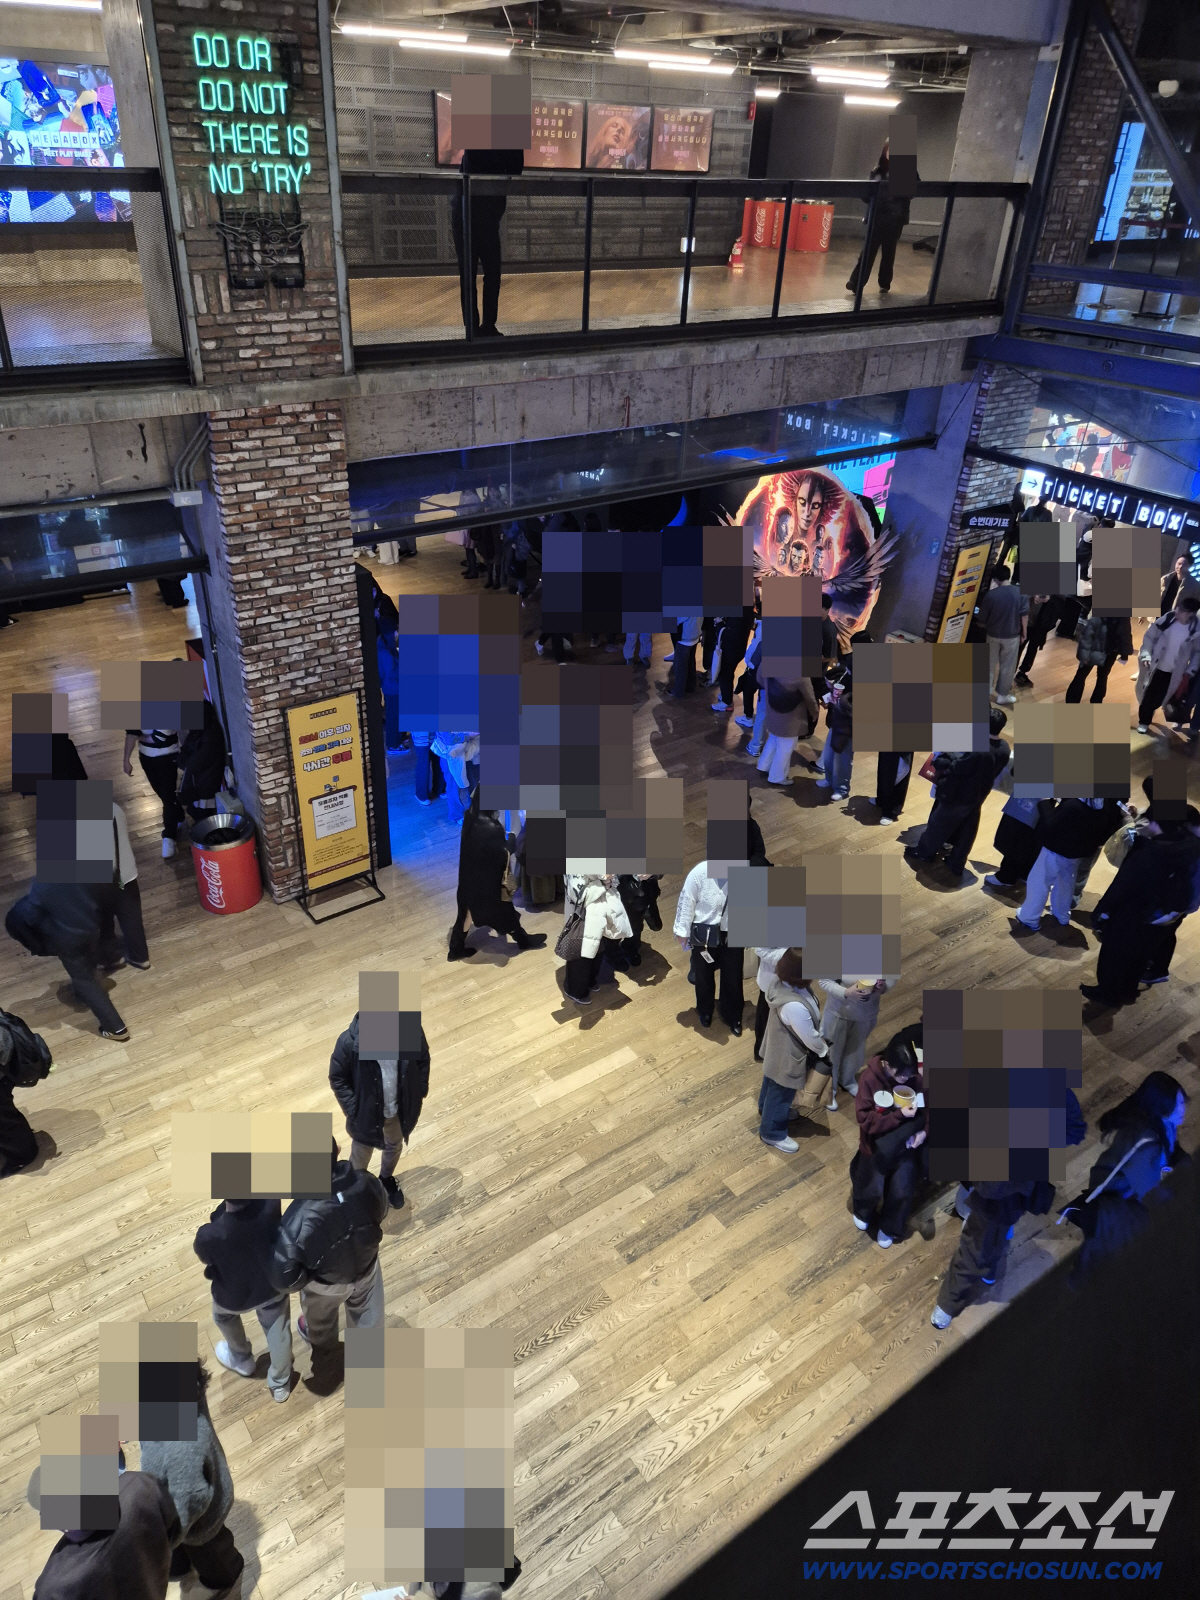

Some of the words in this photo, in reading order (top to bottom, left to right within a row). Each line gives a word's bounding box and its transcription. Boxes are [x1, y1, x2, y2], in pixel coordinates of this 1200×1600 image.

[193, 33, 230, 68] DO
[237, 36, 272, 72] OR
[199, 78, 235, 112] DO
[241, 81, 288, 115] NOT
[31, 133, 99, 145] MEGABOX
[202, 120, 281, 155] THERE
[286, 123, 309, 157] IS
[208, 161, 245, 195] NO
[969, 515, 1011, 528] 순번대기표
[1044, 480, 1123, 514] TICKET
[1138, 505, 1182, 532] BOX
[303, 756, 331, 773] 4시간
